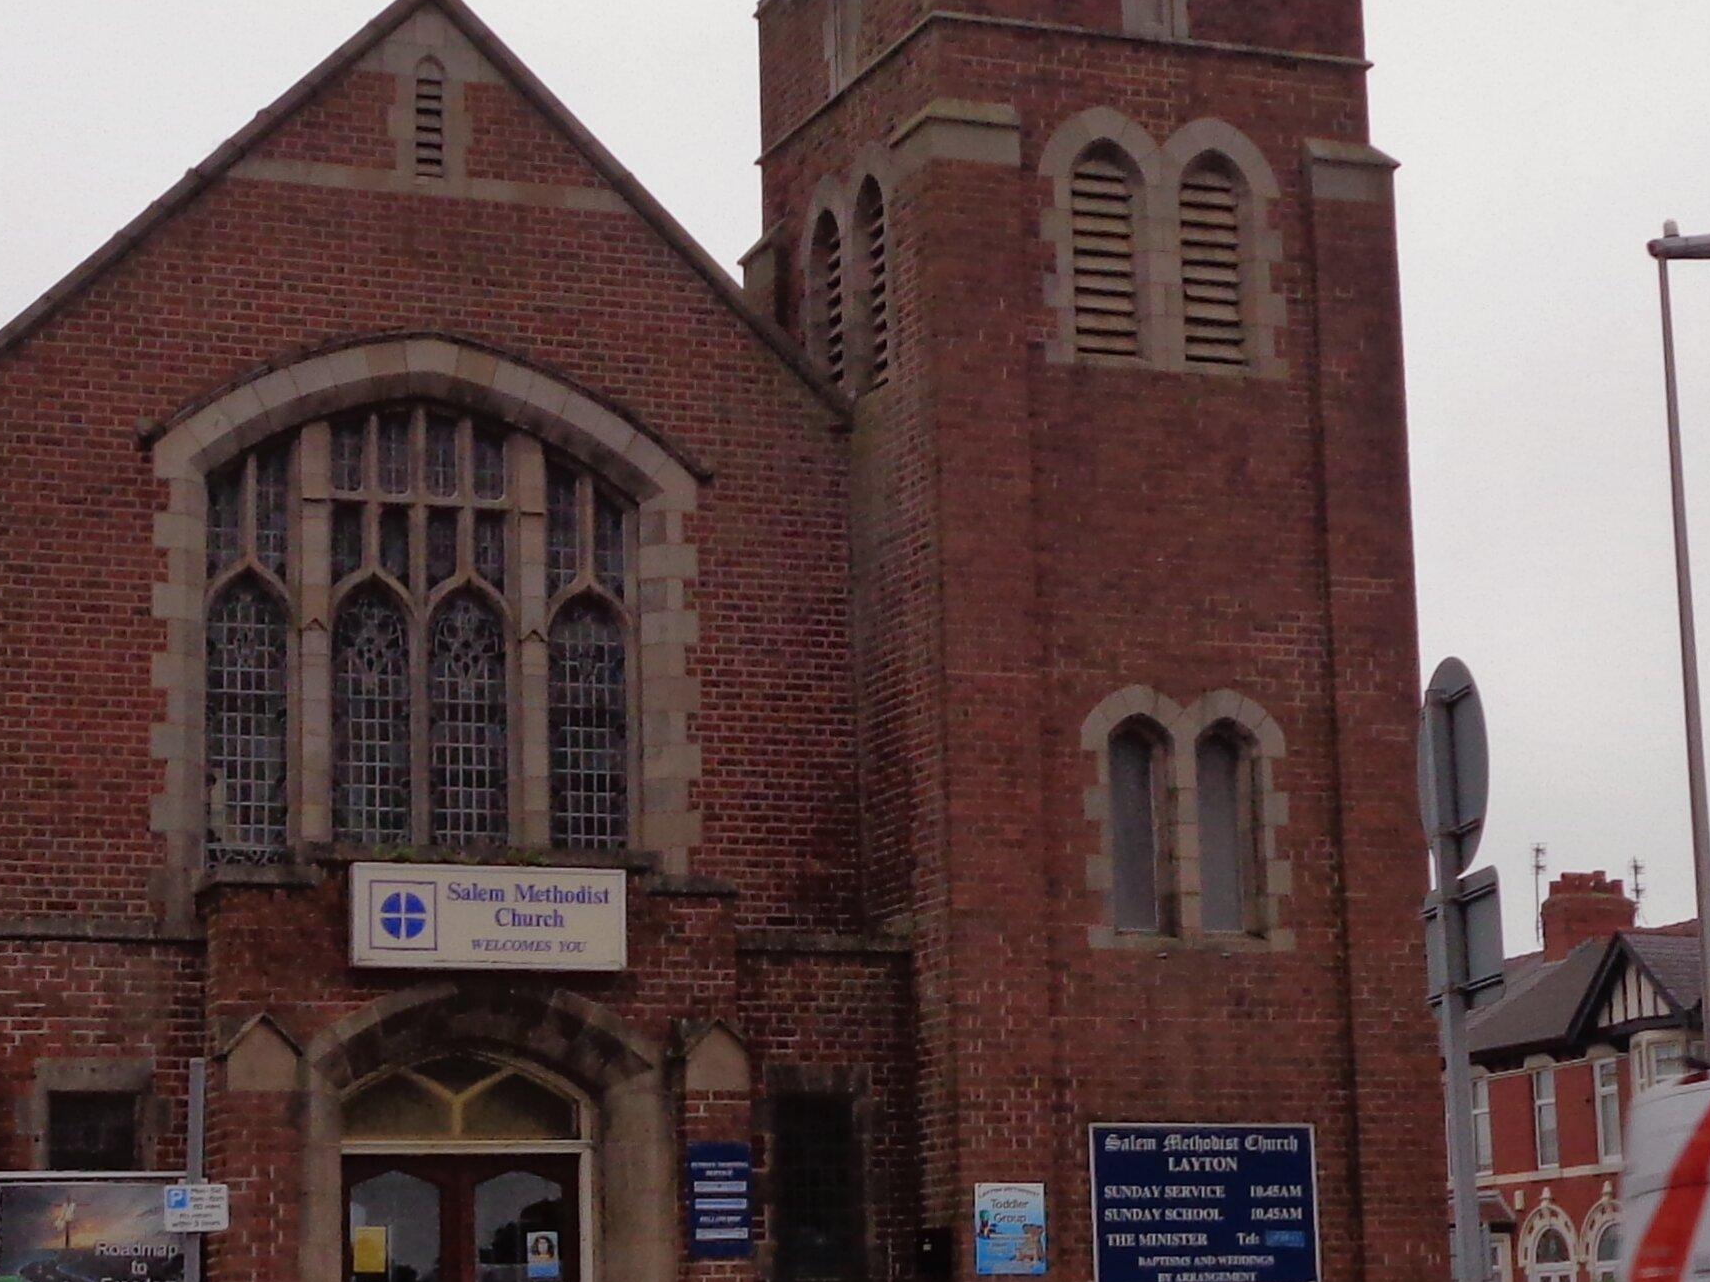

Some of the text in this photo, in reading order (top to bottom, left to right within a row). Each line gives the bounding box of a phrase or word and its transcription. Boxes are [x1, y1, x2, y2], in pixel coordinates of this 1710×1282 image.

[447, 882, 610, 904] Salem Methodist
[494, 907, 565, 928] Church
[471, 938, 588, 953] WELCOMES YOU
[1104, 1134, 1299, 1153] Salem Methodist Church
[1168, 1157, 1238, 1172] LAYTON
[169, 1190, 183, 1207] P
[1104, 1185, 1163, 1198] SUNDAY
[1164, 1185, 1225, 1198] SERVICE
[994, 1212, 1027, 1223] Group
[1104, 1208, 1163, 1221] SUNDAY
[1165, 1208, 1223, 1221] SCHOOL
[1106, 1233, 1136, 1246] THE
[1139, 1233, 1208, 1246] MINISTER
[95, 1242, 179, 1261] Roadmap
[131, 1260, 148, 1275] to
[1138, 1255, 1275, 1266] BAPTISMS AND WEDDINGS
[1157, 1271, 1258, 1282] BY ARRANGEMENT
